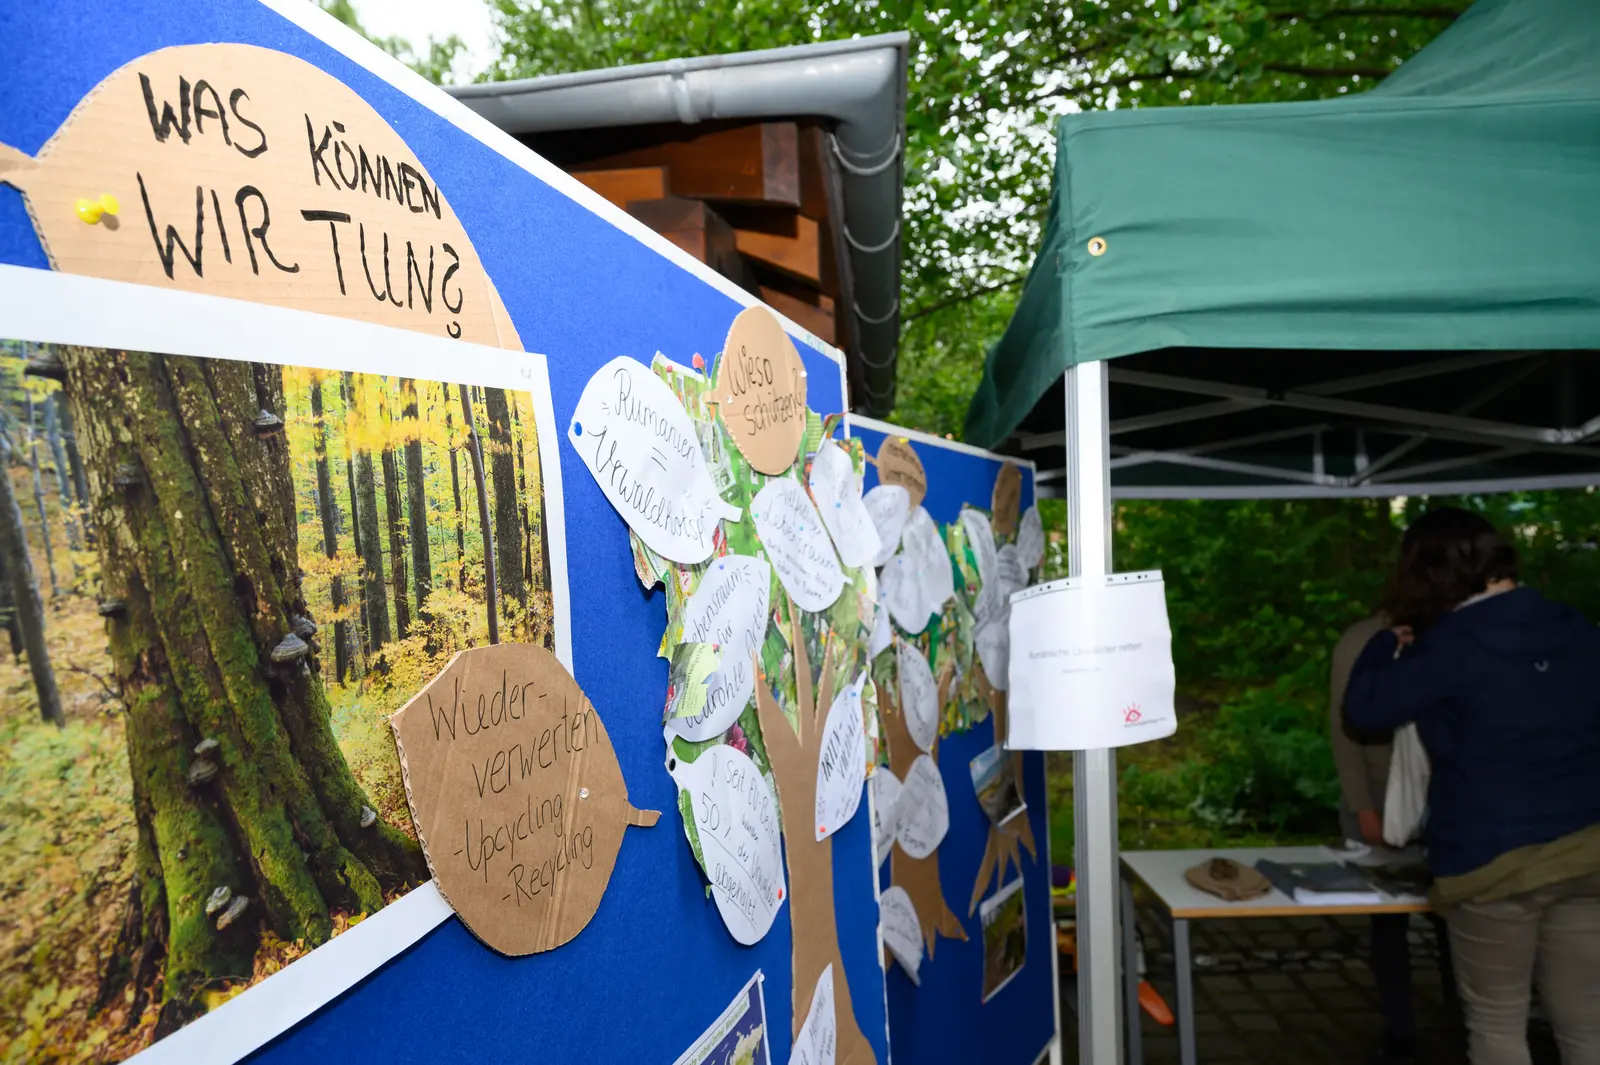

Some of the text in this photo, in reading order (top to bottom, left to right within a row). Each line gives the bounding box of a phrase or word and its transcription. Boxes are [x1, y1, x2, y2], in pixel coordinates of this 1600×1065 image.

[138, 72, 441, 220] WAS KÖNNEN
[137, 171, 463, 339] WIR TUN?
[727, 345, 774, 396] Wieso
[427, 669, 548, 741] Wieder-
[472, 697, 599, 799] verwerten
[725, 759, 746, 794] Seit
